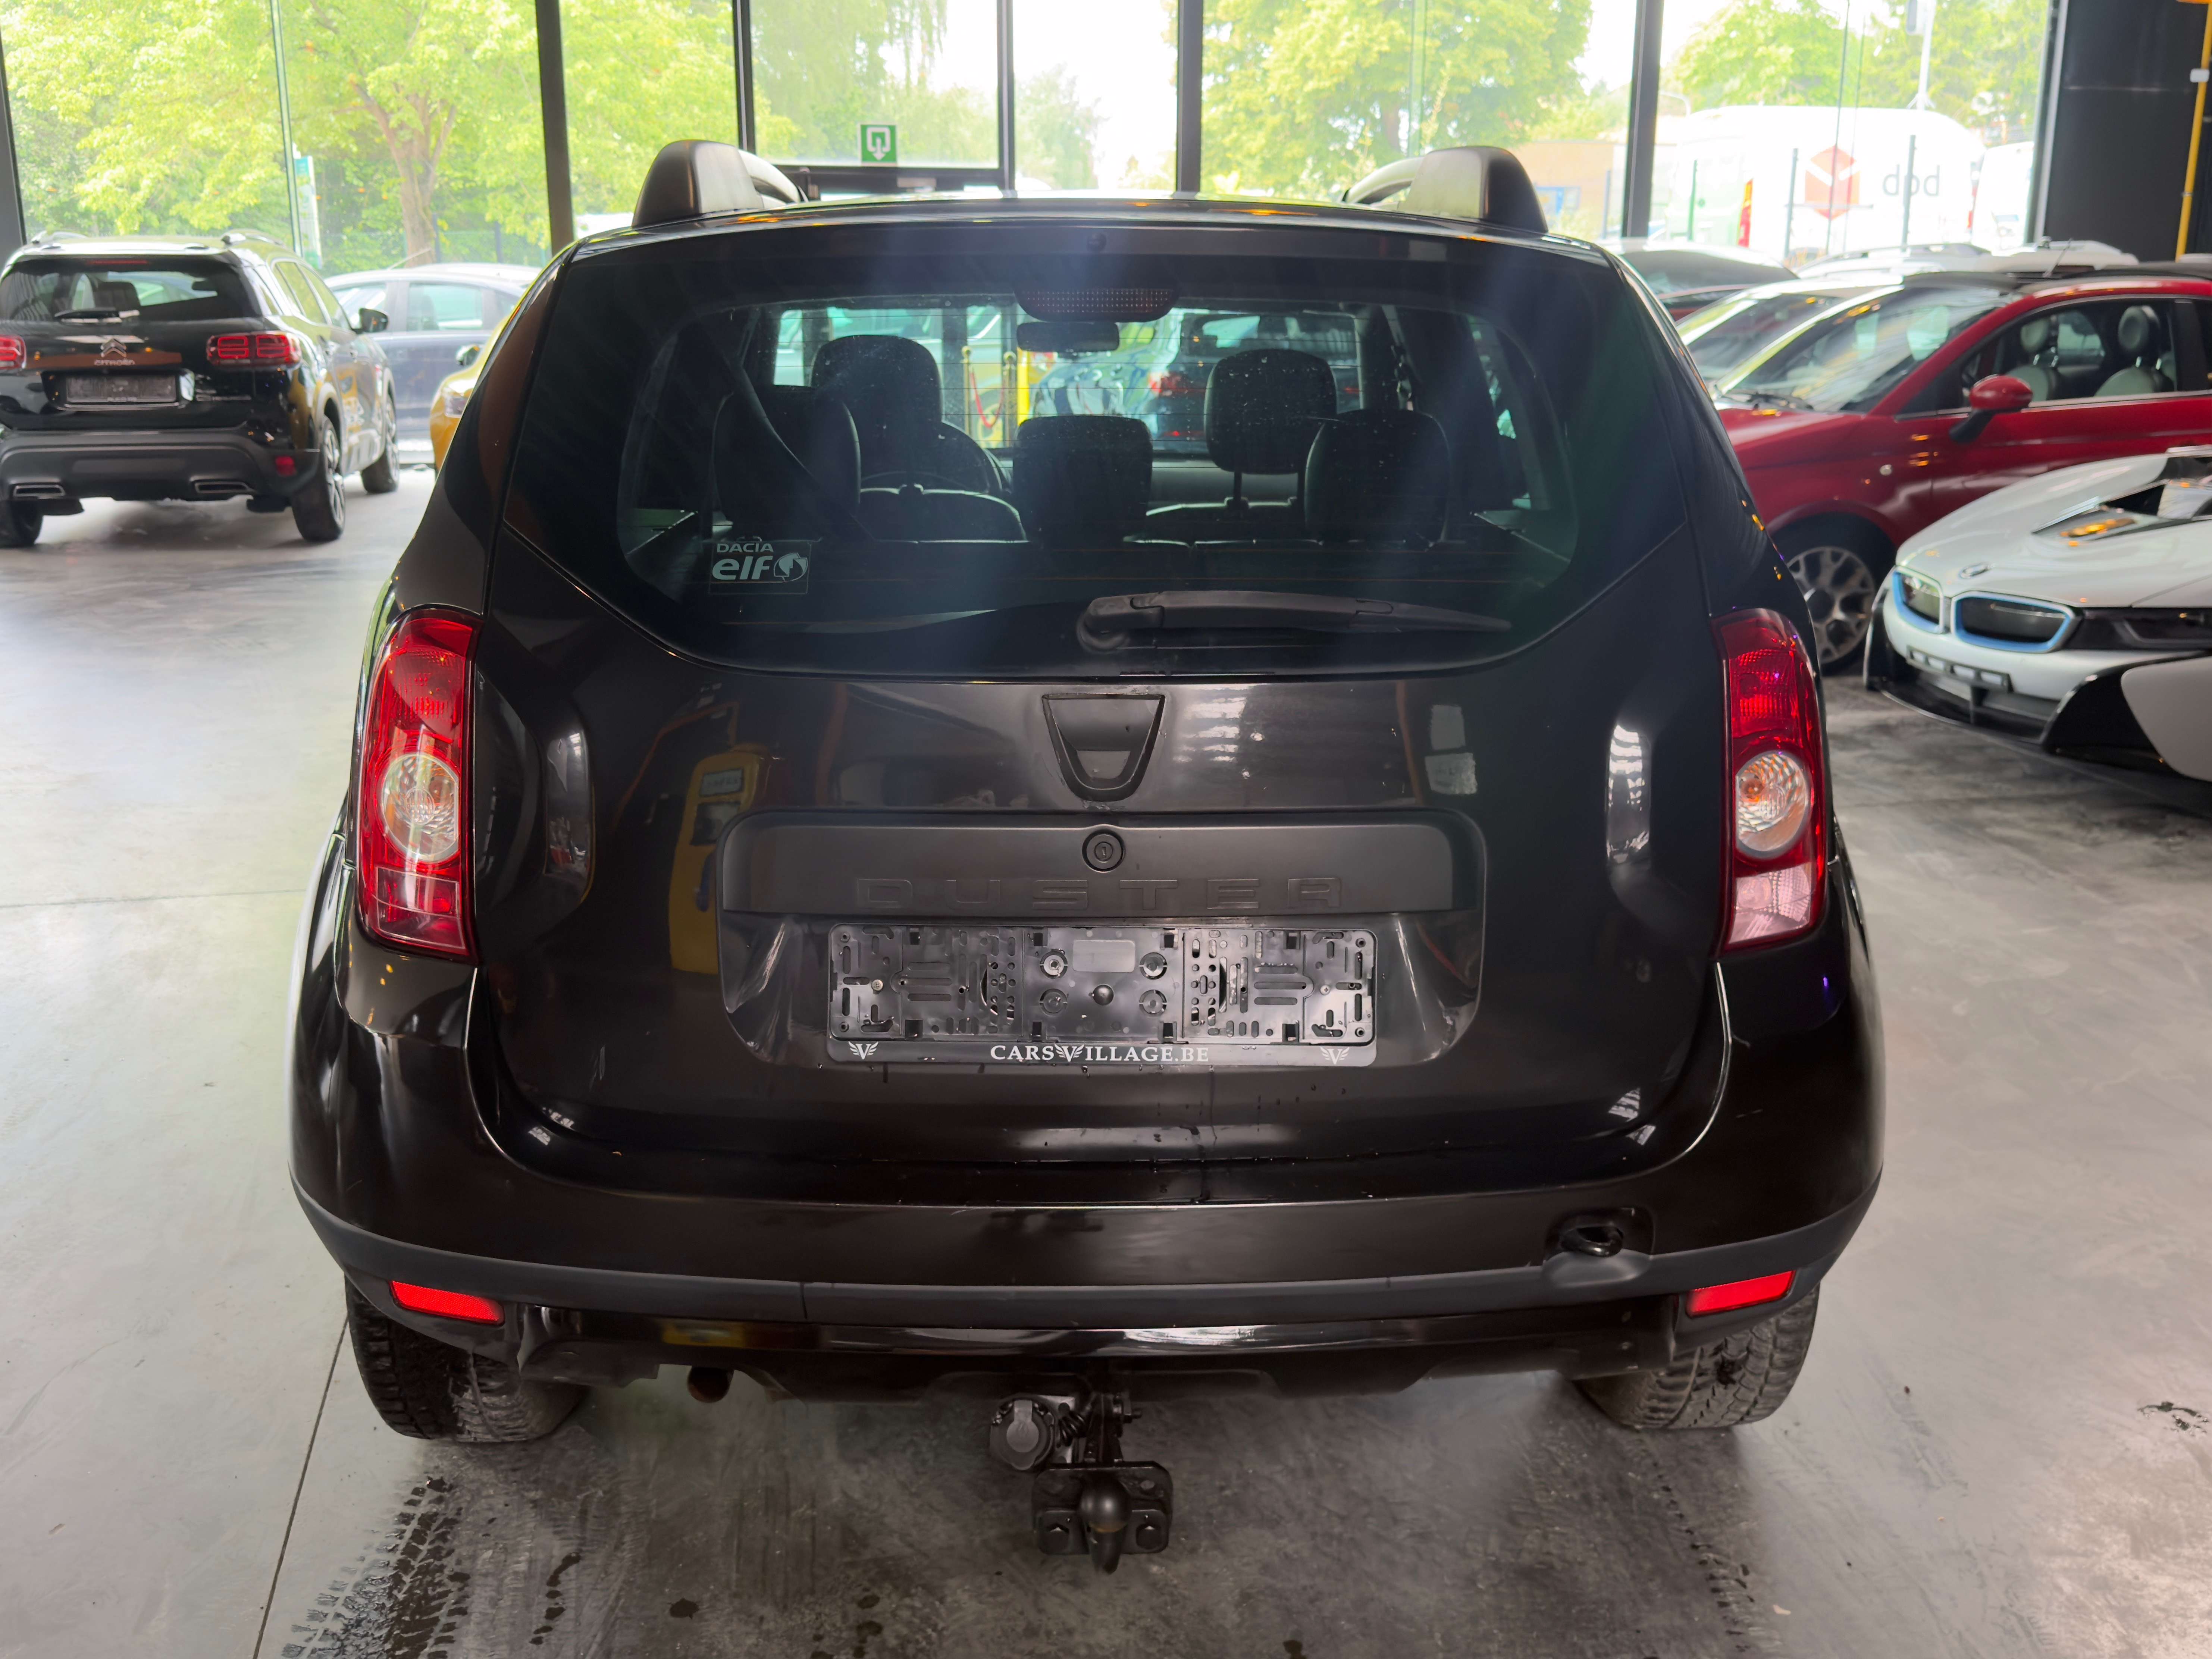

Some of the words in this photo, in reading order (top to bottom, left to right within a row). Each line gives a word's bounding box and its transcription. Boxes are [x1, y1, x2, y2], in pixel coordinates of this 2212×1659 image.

[1882, 164, 1940, 206] dpd
[716, 543, 774, 553] DACIA
[712, 556, 774, 580] elf
[856, 878, 1341, 911] DUSTER
[990, 1044, 1209, 1063] CARSVILLAGE.BE
